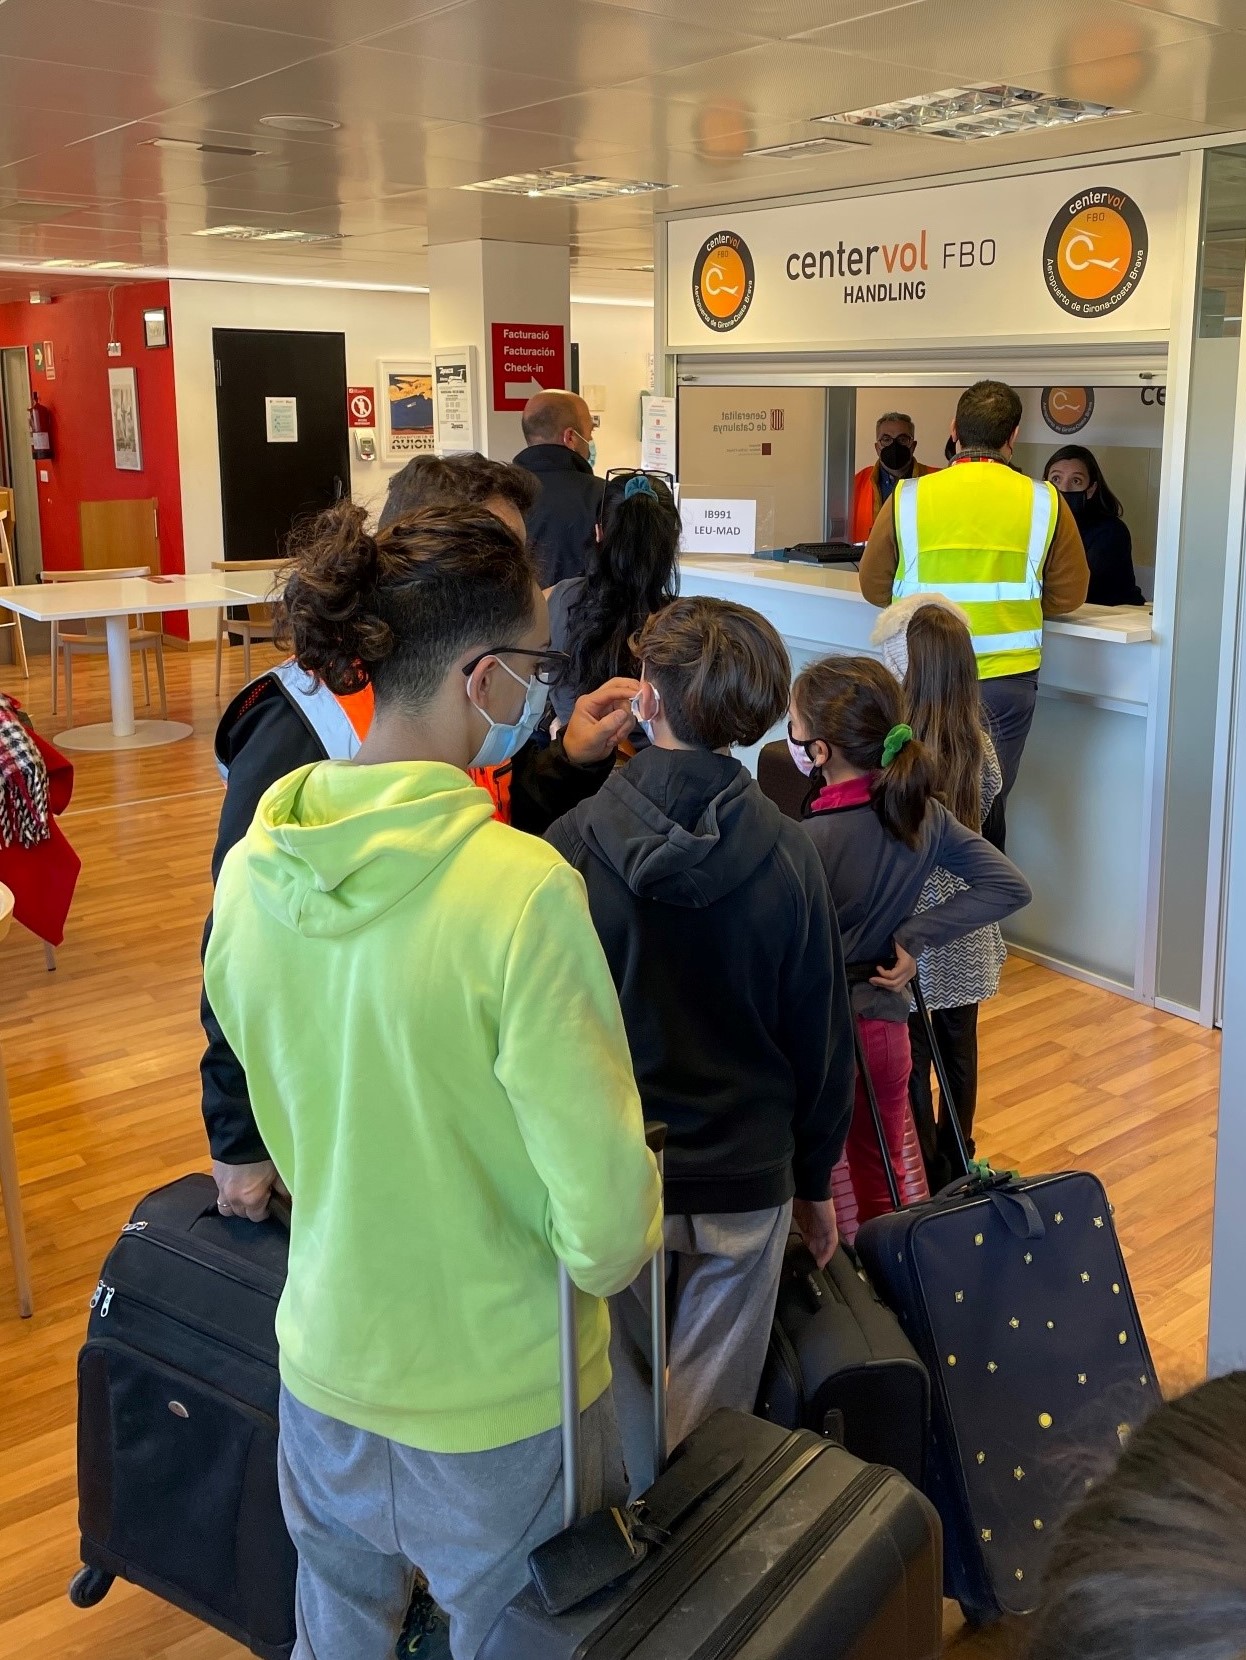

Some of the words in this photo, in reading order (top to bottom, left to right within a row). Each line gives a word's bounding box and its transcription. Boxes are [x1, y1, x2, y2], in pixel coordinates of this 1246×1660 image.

[1069, 191, 1126, 214] centervol
[1086, 212, 1105, 222] FBO
[706, 234, 740, 252] centervol
[717, 250, 729, 258] FBO
[786, 229, 928, 281] centervol
[943, 238, 996, 269] FBO
[1046, 258, 1069, 306] Aeropuerto
[1071, 301, 1081, 312] de
[1129, 249, 1144, 280] Brava
[843, 280, 926, 304] HANDLING
[503, 329, 550, 340] Facturació
[503, 346, 556, 357] Facturación
[504, 362, 544, 373] Check-in
[704, 510, 732, 519] IB991
[694, 526, 741, 536] LEU-MAD
